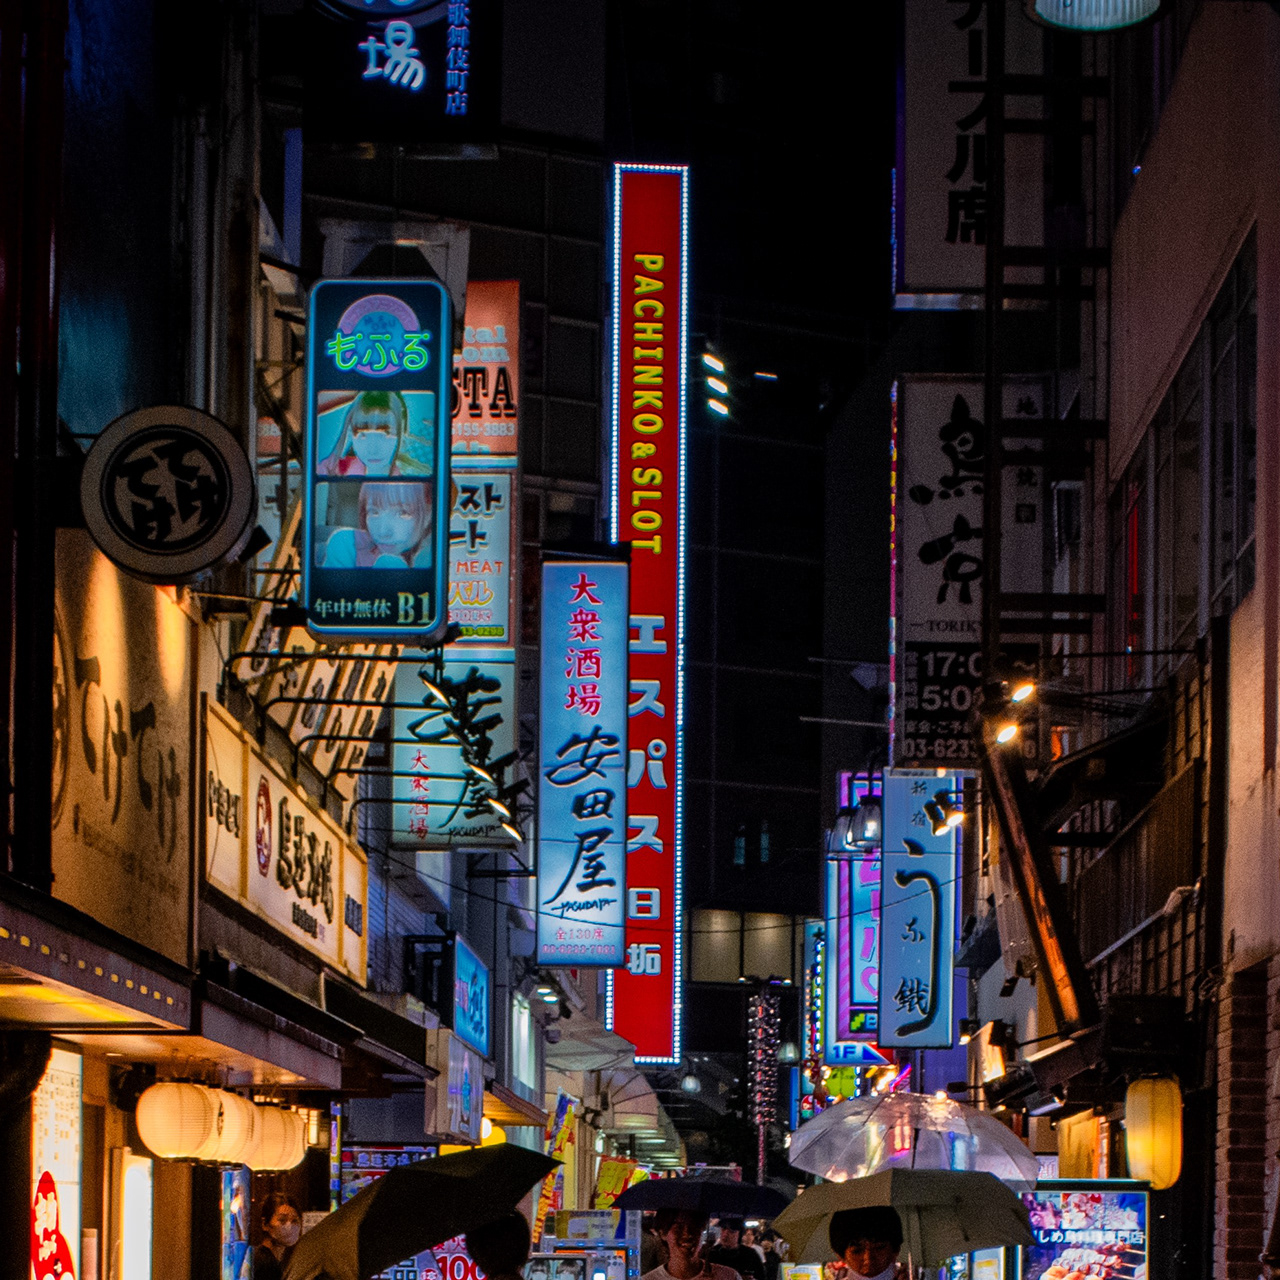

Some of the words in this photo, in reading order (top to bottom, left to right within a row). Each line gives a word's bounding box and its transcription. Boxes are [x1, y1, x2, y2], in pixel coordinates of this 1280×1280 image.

[357, 20, 426, 91] 場
[631, 253, 666, 435] PACHINKO
[630, 441, 657, 460] &
[630, 466, 664, 555] SLOT
[456, 561, 504, 574] MEAT
[314, 597, 392, 619] 年中無休
[397, 591, 432, 623] B1
[565, 571, 604, 716] 大衆酒場
[542, 724, 621, 905] 安田屋
[832, 1044, 858, 1060] 1F
